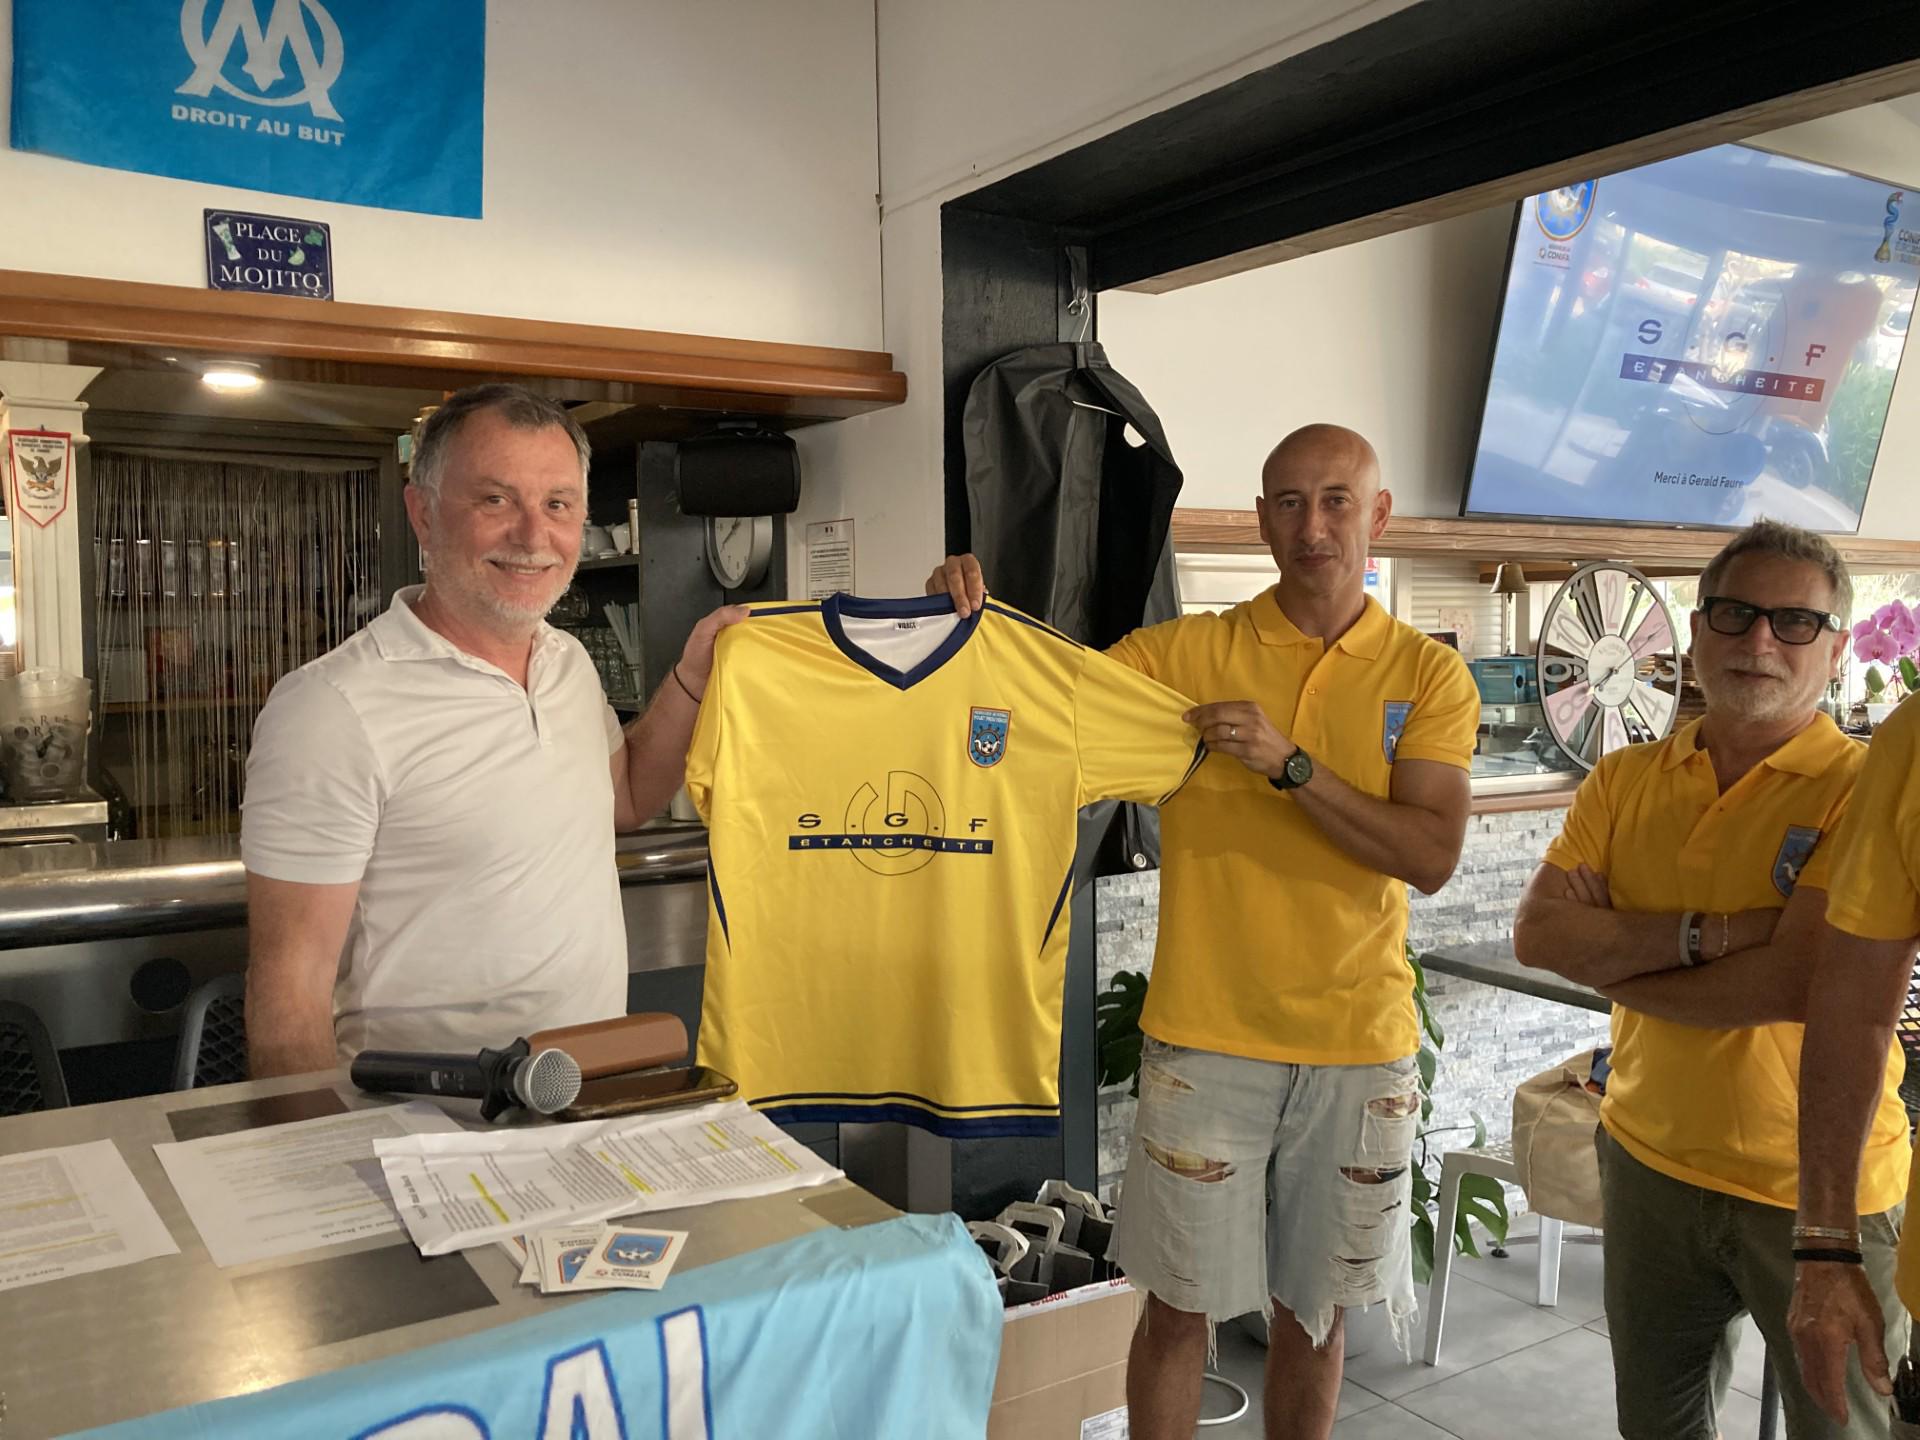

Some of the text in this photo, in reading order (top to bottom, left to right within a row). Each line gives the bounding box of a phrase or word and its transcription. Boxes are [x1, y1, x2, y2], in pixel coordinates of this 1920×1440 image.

[171, 104, 345, 146] DROIT AU BUT
[235, 222, 301, 243] PLACE
[258, 248, 282, 262] DU
[220, 265, 322, 290] MOJITO
[1654, 471, 1680, 485] Merci
[1688, 474, 1718, 488] Gerald
[800, 838, 984, 851] ETANCHEITE
